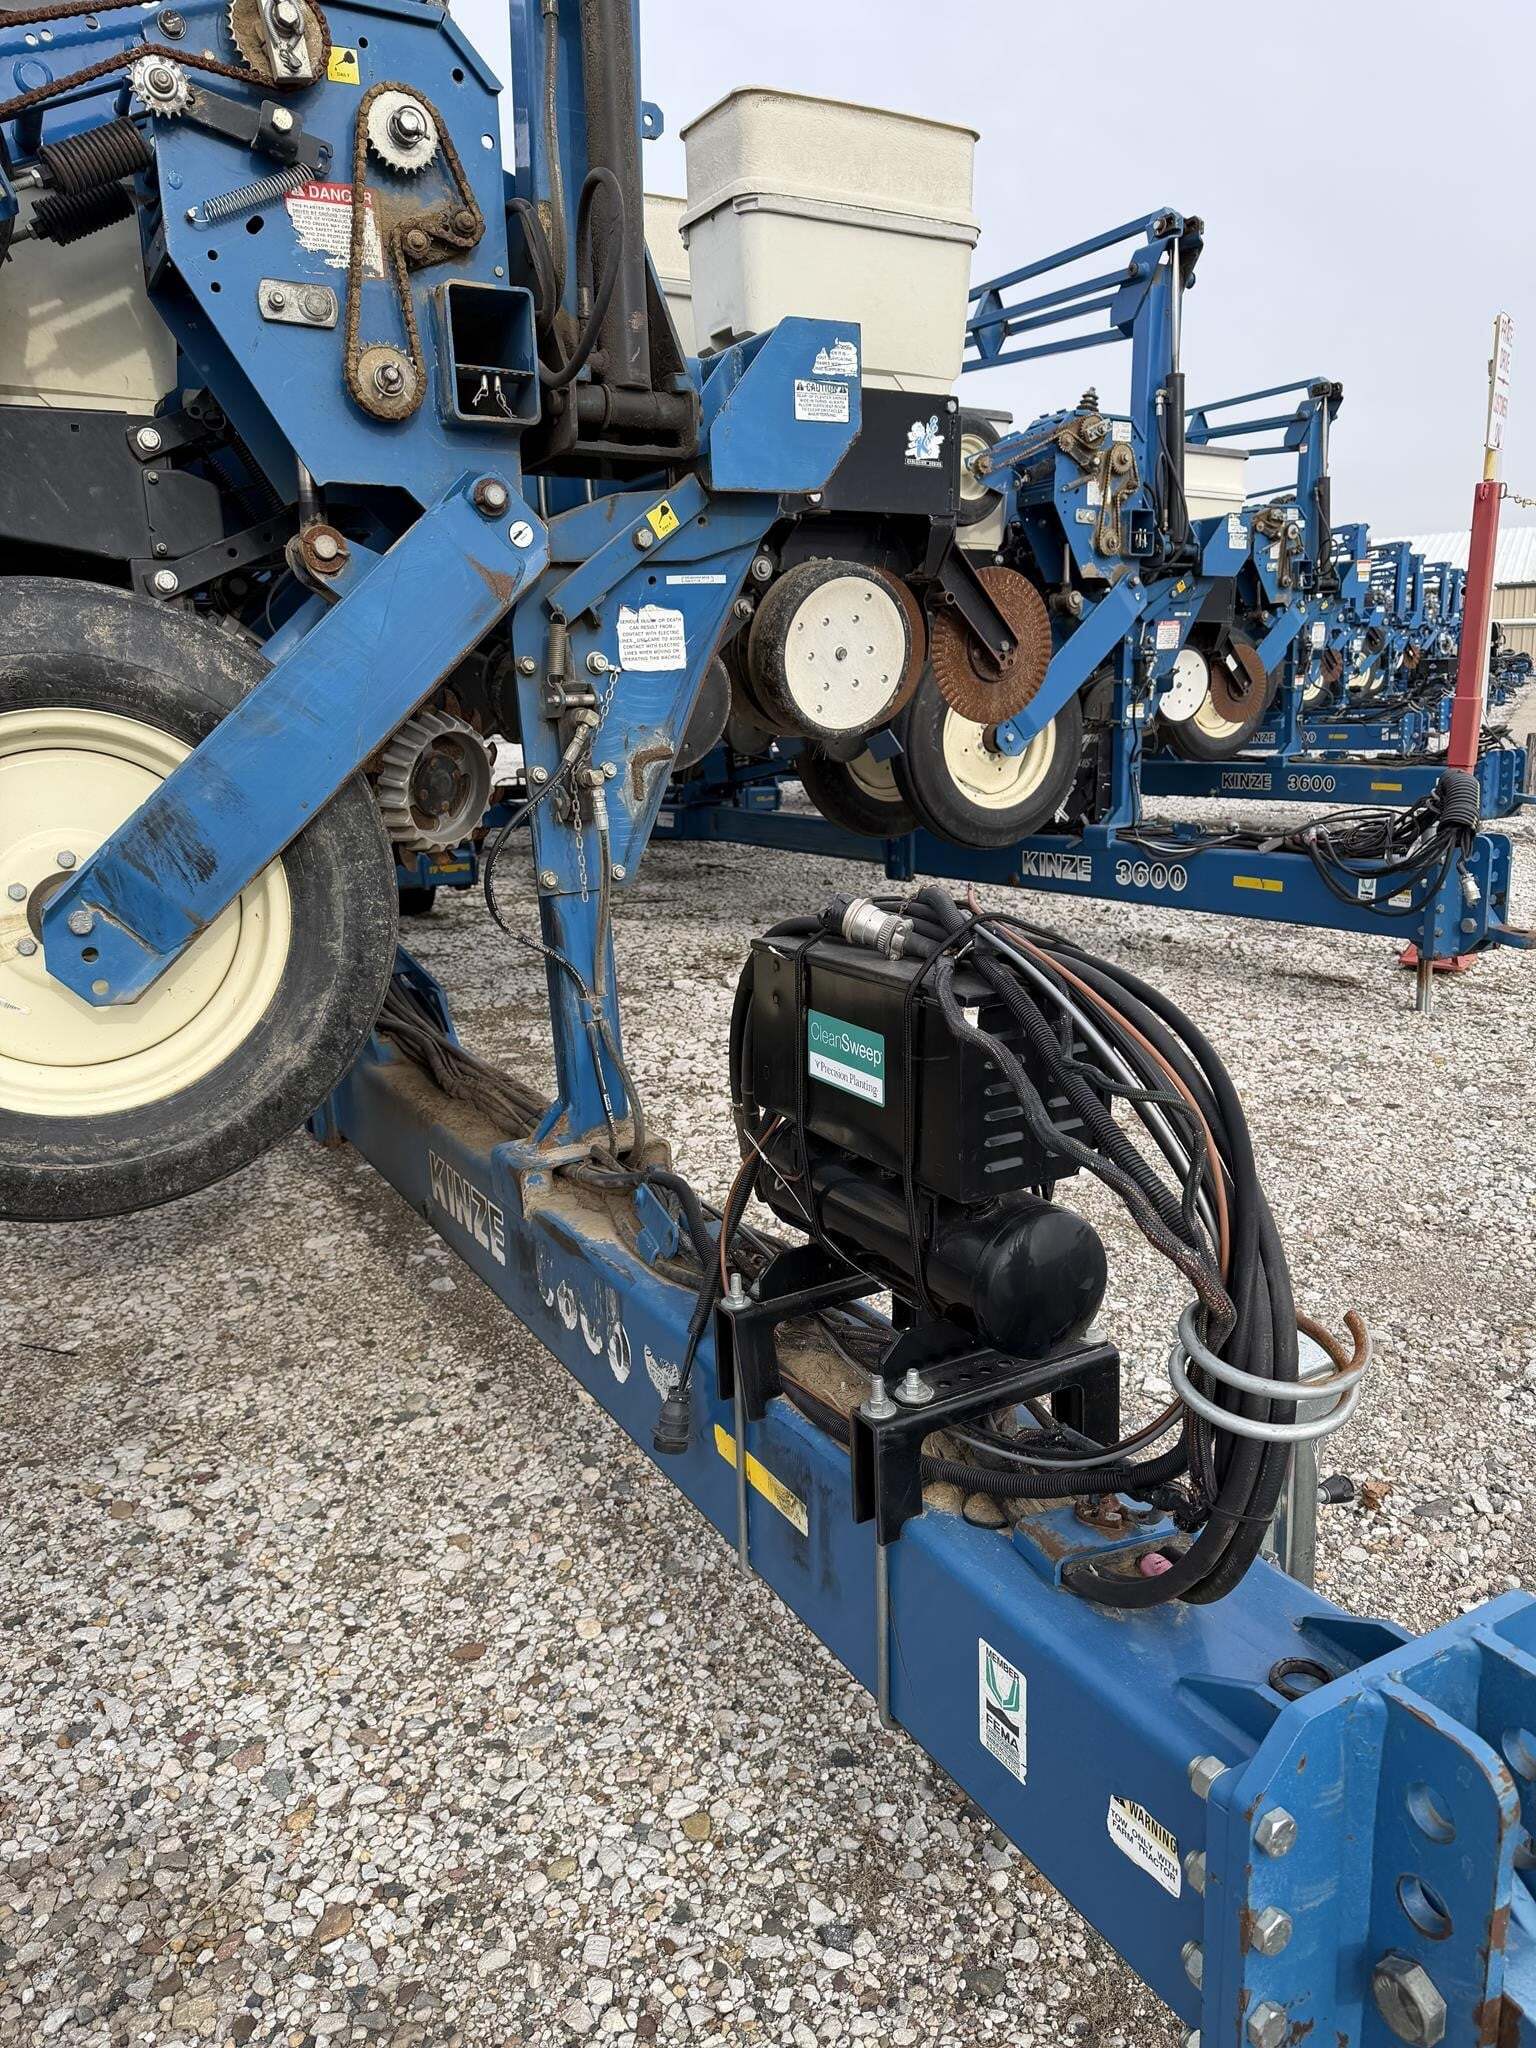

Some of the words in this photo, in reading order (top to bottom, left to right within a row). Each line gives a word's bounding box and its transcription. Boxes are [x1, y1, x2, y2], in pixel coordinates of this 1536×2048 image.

[309, 185, 372, 206] DANGR
[1221, 772, 1272, 791] KINZE
[1287, 774, 1336, 792] 3600
[1022, 850, 1092, 882] KINZE
[1115, 859, 1188, 892] 3600
[811, 1022, 882, 1067] CleanSweep
[820, 1061, 849, 1082] Precision
[849, 1073, 878, 1098] Planting
[428, 1149, 506, 1267] KINZE
[985, 1646, 1020, 1681] MEMBER
[986, 1713, 1019, 1752] FEMA
[1111, 1807, 1128, 1828] TOW
[1131, 1828, 1153, 1852] ONLY
[1157, 1850, 1179, 1876] WITH
[1129, 1801, 1177, 1855] WARNING
[1112, 1819, 1134, 1844] FARM
[1137, 1842, 1176, 1883] TRACTOR
